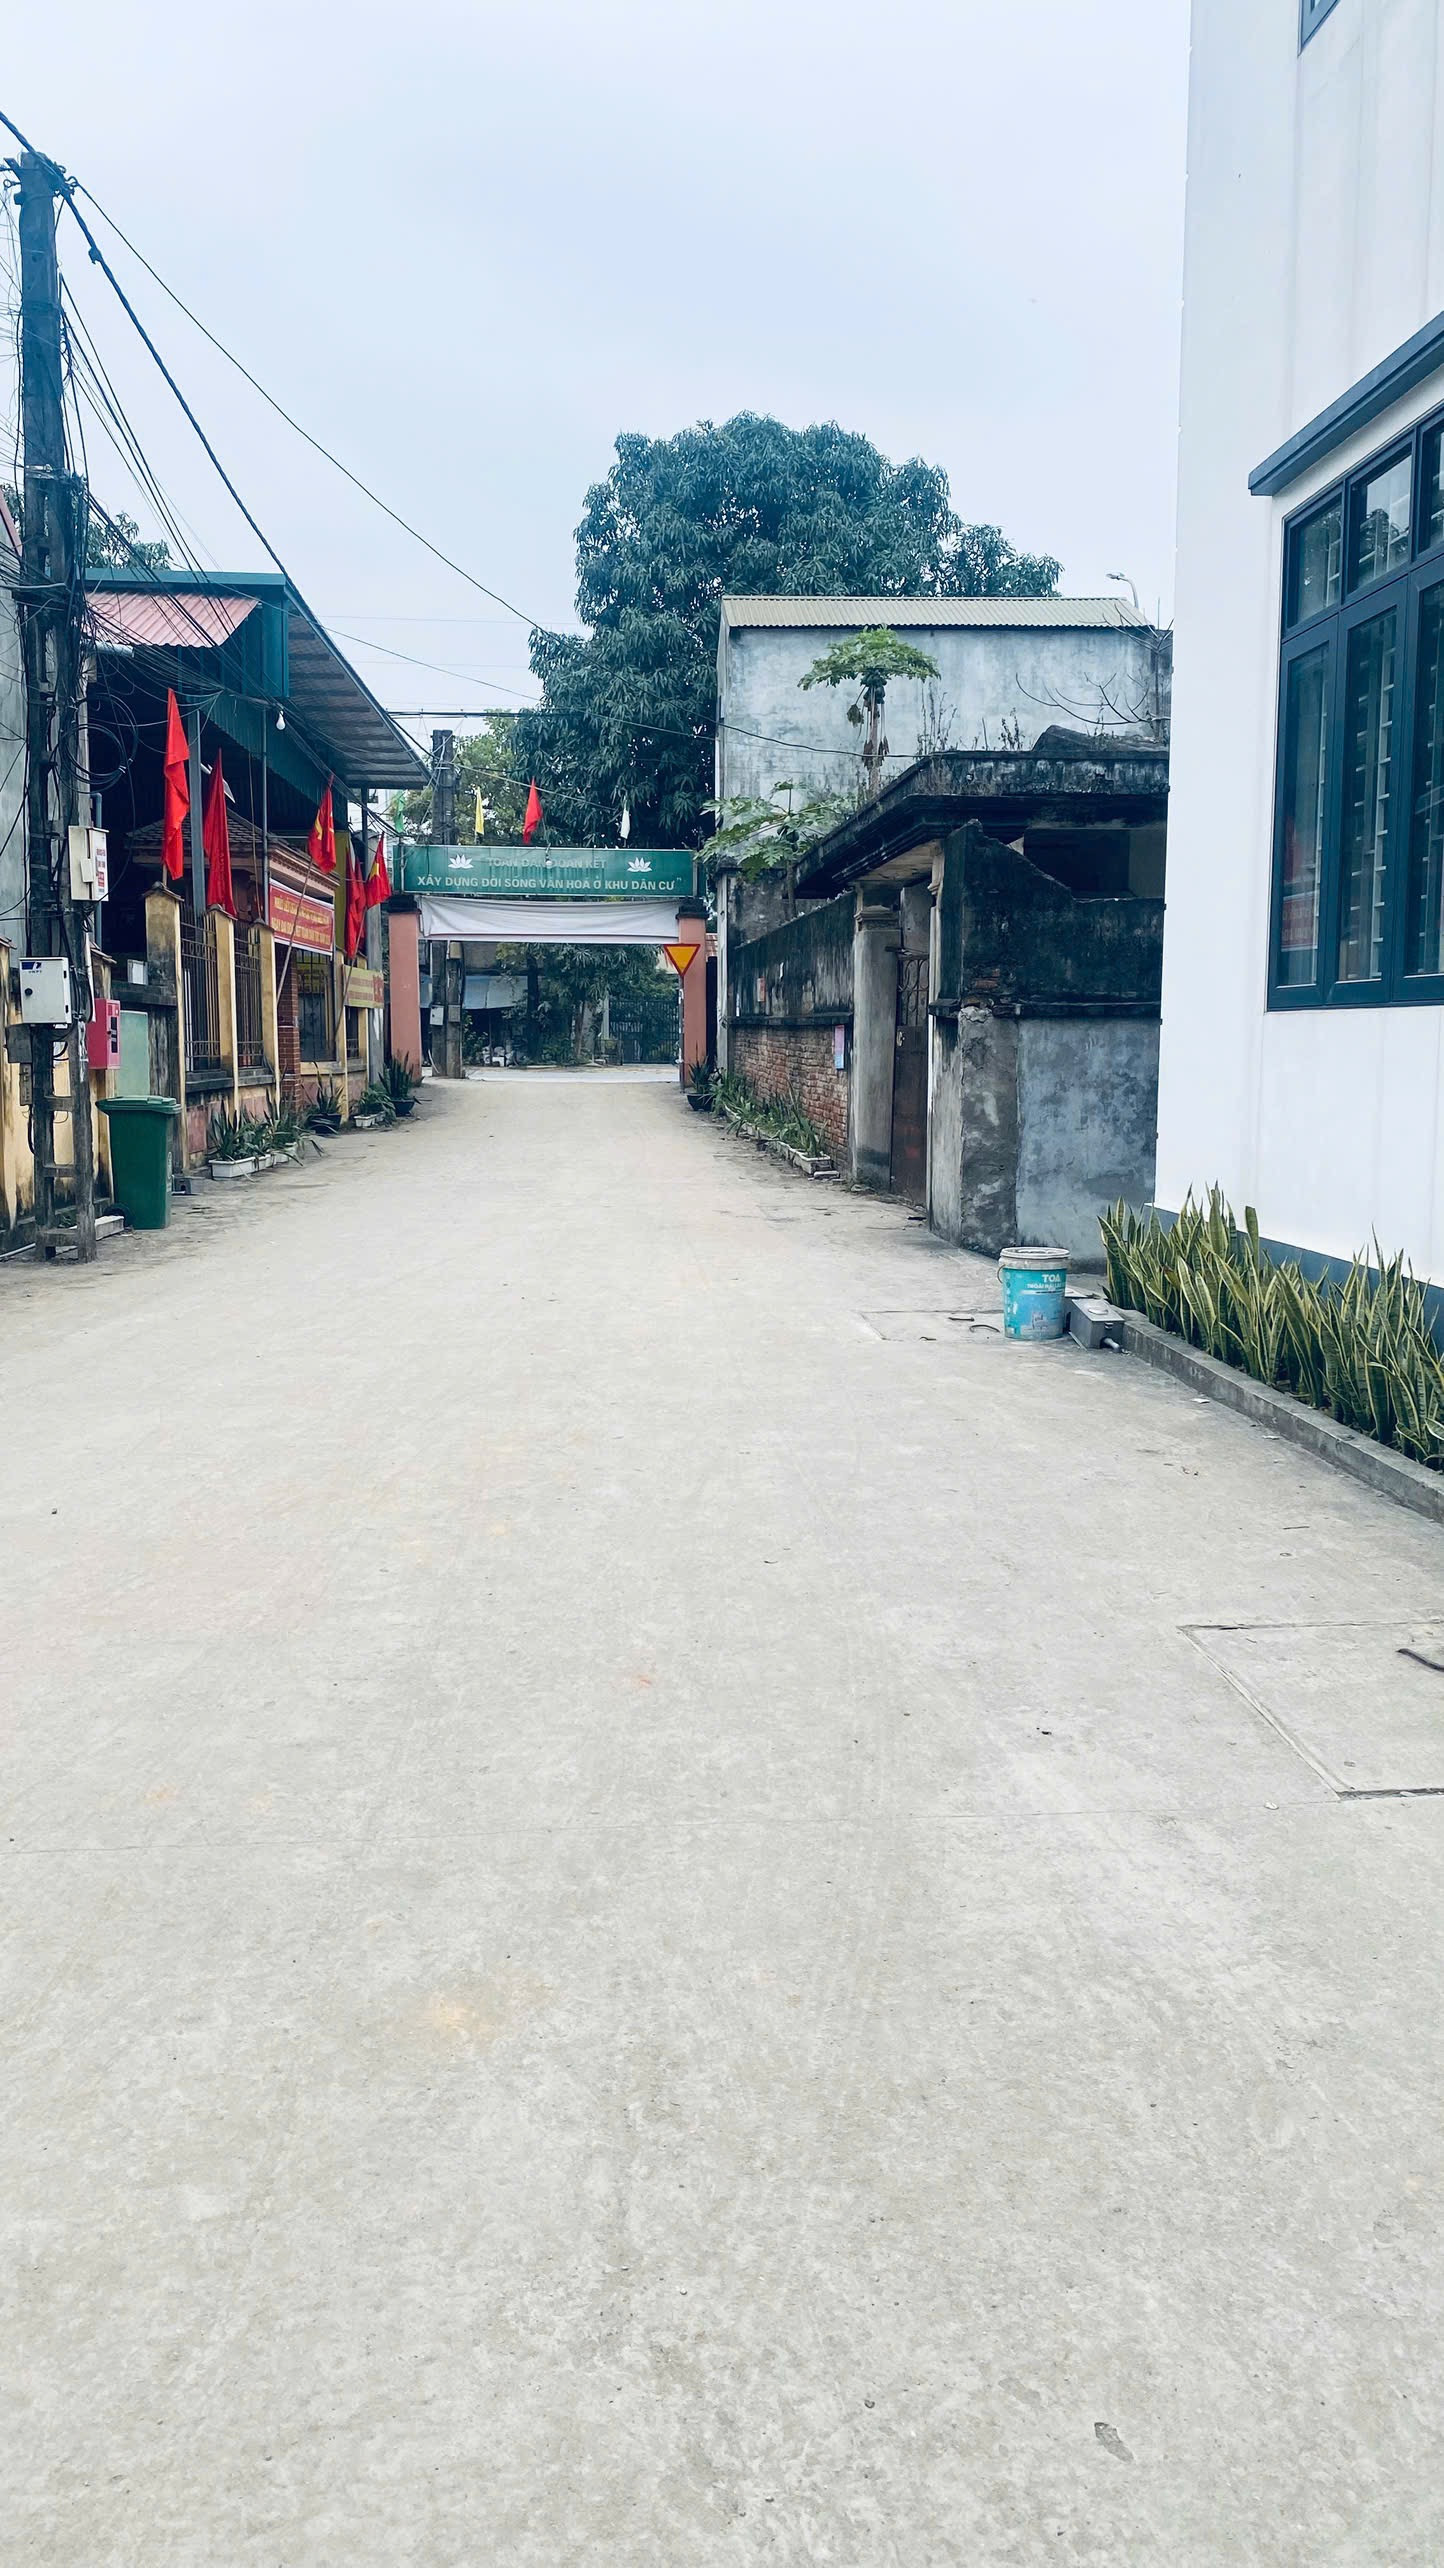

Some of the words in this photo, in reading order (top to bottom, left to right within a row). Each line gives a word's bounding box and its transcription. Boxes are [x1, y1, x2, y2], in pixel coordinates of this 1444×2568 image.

[418, 874, 442, 886] XÂY
[445, 876, 478, 889] DỰNG
[481, 874, 502, 888] ĐỜI
[593, 875, 602, 889] Ở
[605, 880, 628, 890] KHU
[631, 878, 656, 890] DÂN
[1042, 1273, 1061, 1282] TOA
